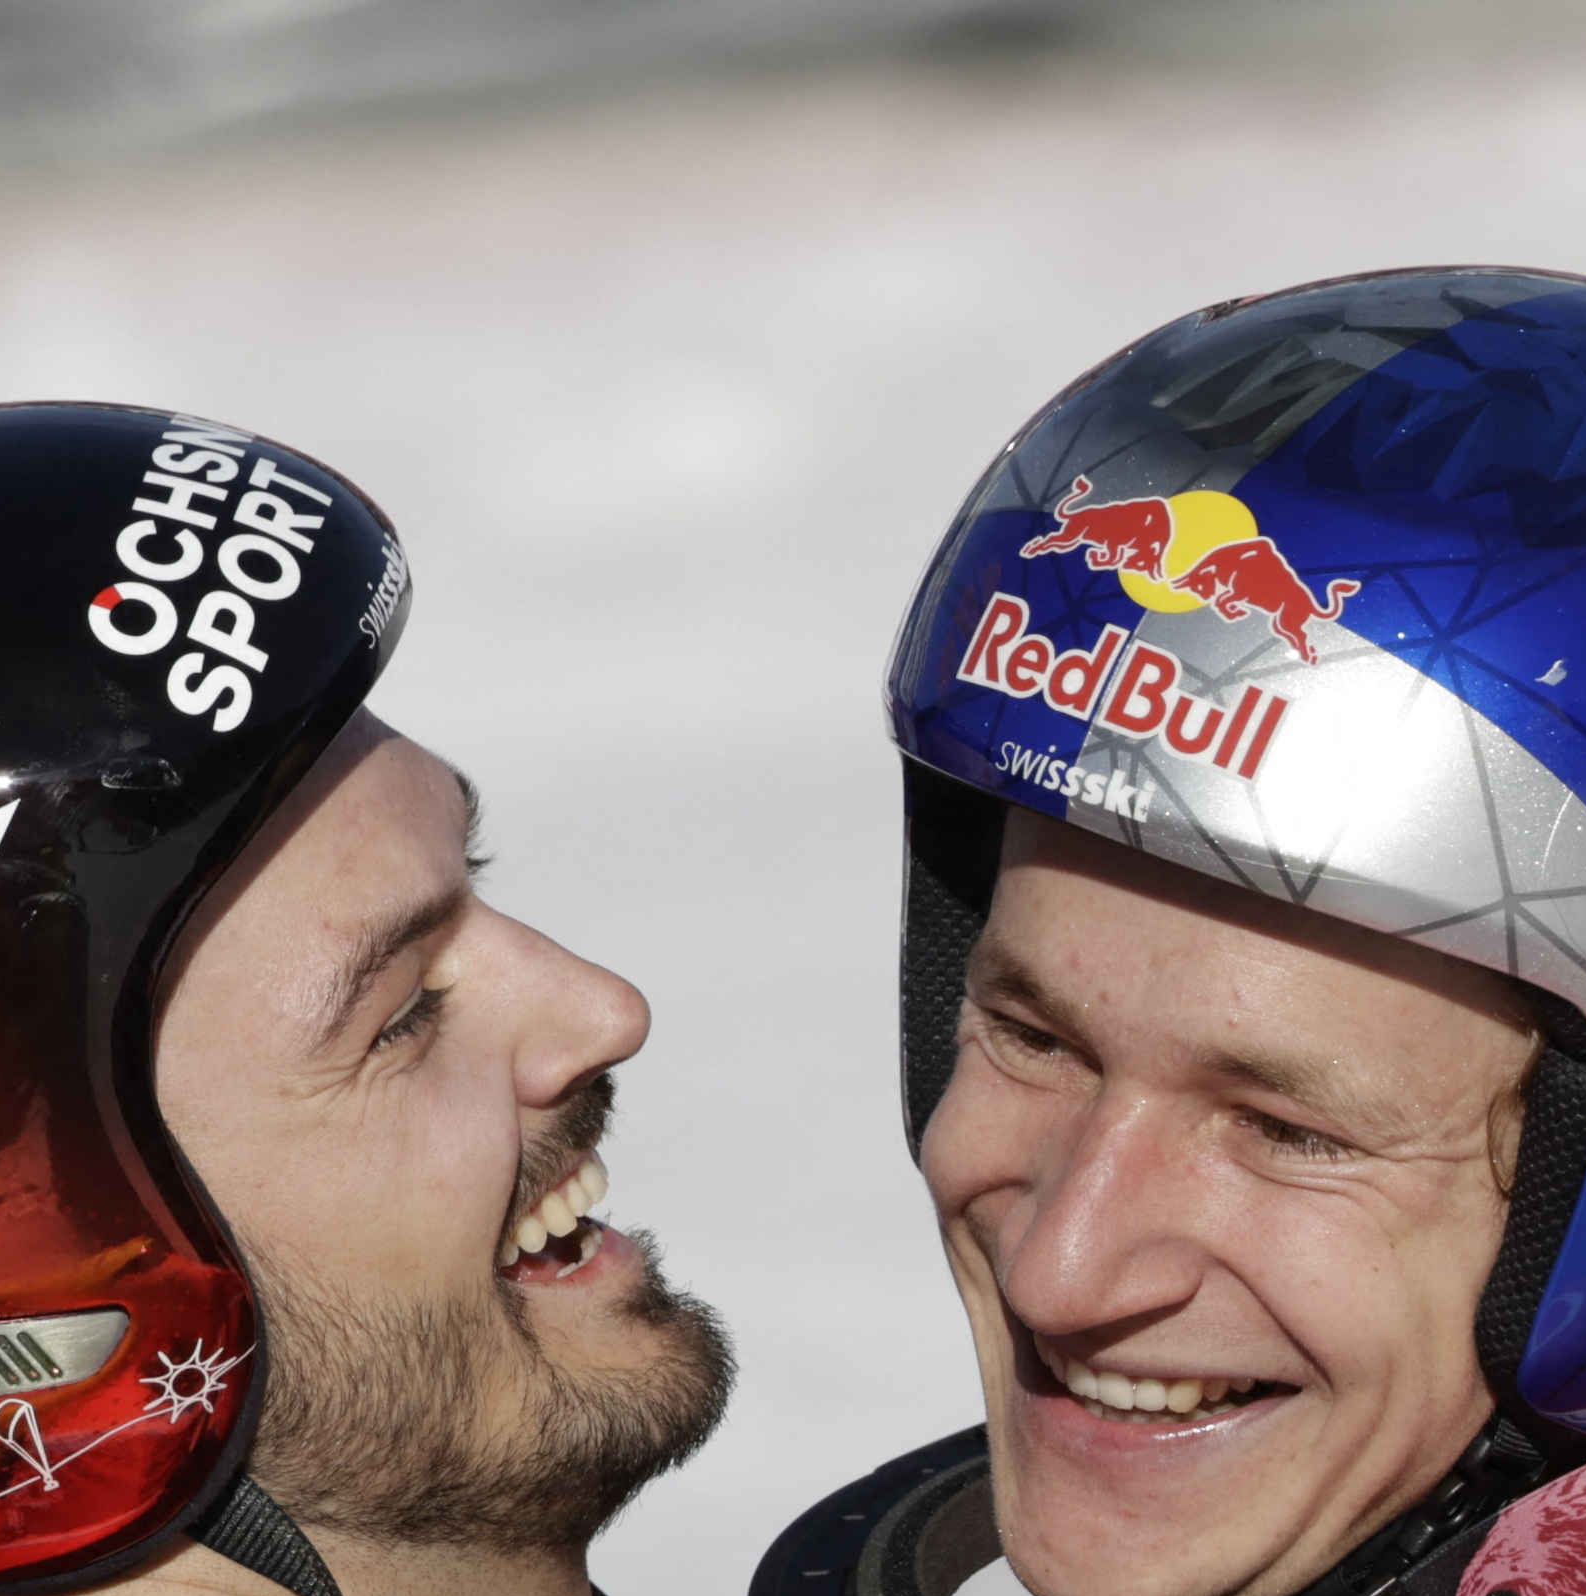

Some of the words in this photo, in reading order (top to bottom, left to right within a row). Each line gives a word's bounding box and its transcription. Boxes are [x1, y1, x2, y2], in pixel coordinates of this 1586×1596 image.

[88, 412, 254, 656] OCHSN
[167, 457, 332, 732] SPORT
[956, 592, 1130, 721] Red
[1095, 638, 1296, 786] Bull
[995, 740, 1157, 823] swissski
